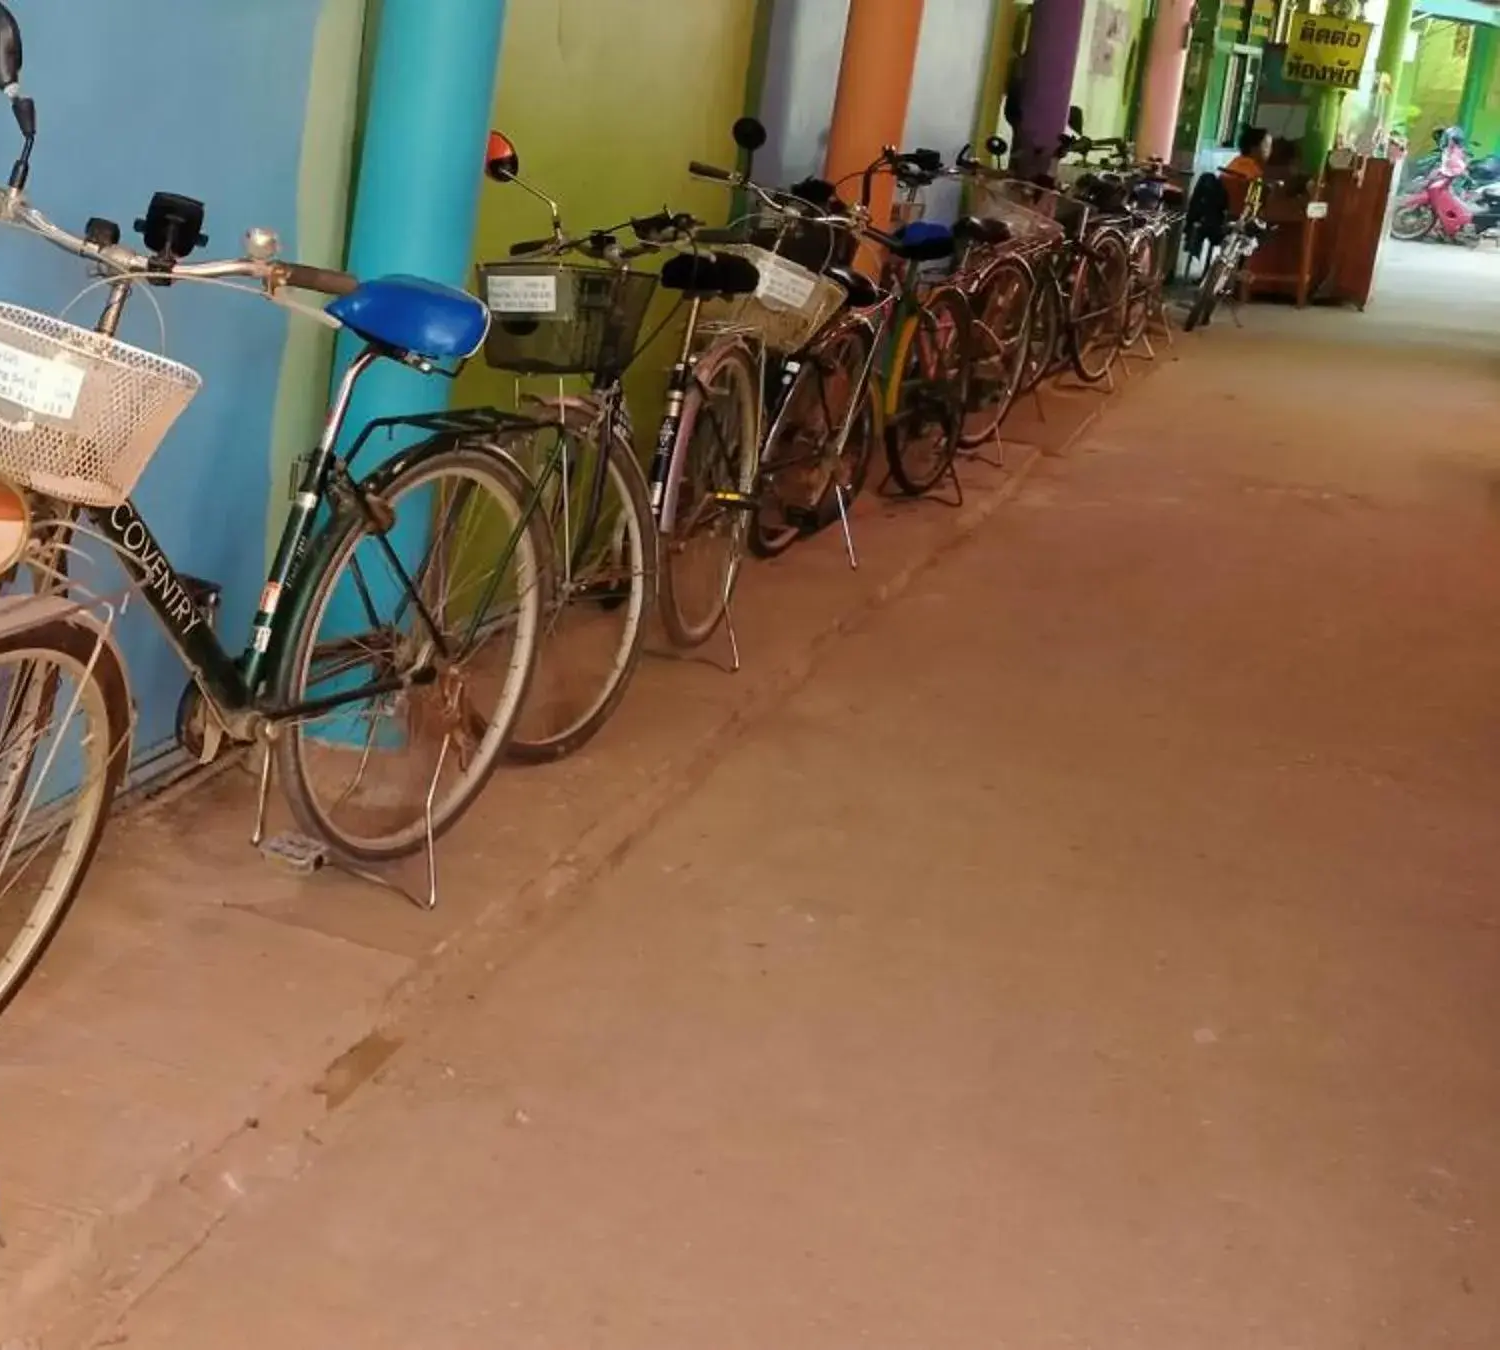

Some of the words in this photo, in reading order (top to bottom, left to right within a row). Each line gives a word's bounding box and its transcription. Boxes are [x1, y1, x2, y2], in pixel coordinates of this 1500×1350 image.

[1300, 19, 1361, 48] ติดต่อ
[1286, 53, 1358, 86] ห้องพัก
[111, 501, 201, 635] COVENTRY
